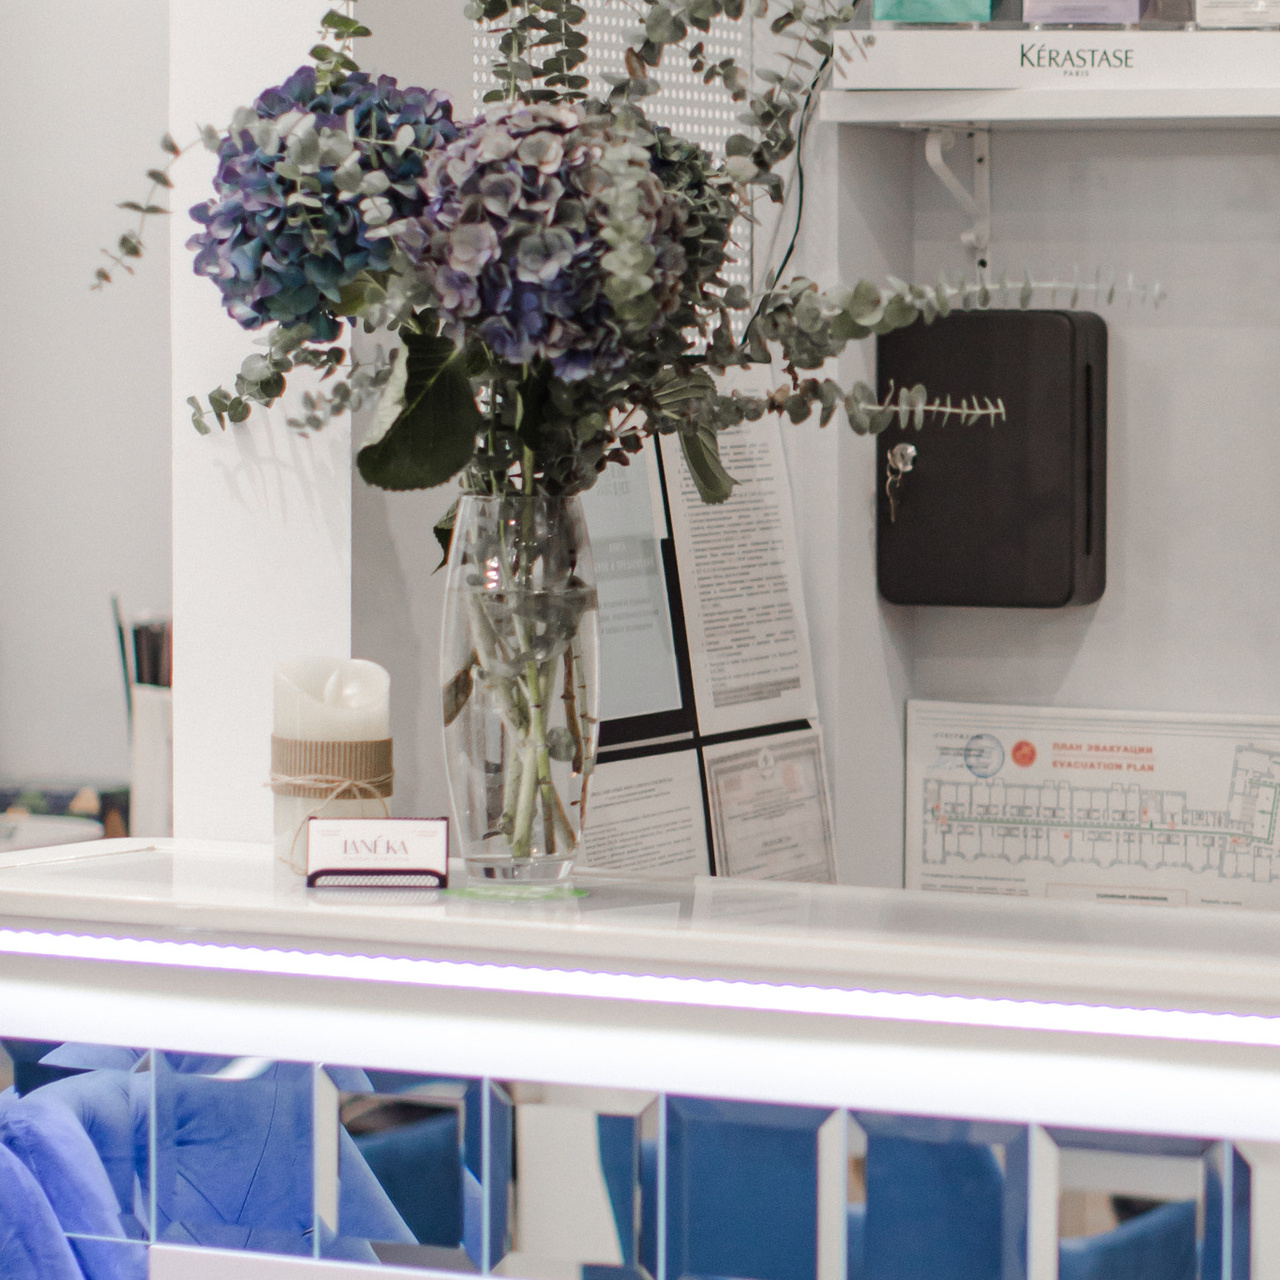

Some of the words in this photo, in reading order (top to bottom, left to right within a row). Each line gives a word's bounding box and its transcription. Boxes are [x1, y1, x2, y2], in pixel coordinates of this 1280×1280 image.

[1020, 43, 1134, 69] KÉRASTASE
[1052, 742, 1083, 752] ПЛАН
[1052, 760, 1122, 771] EVACUATION
[1126, 762, 1155, 772] PLAN
